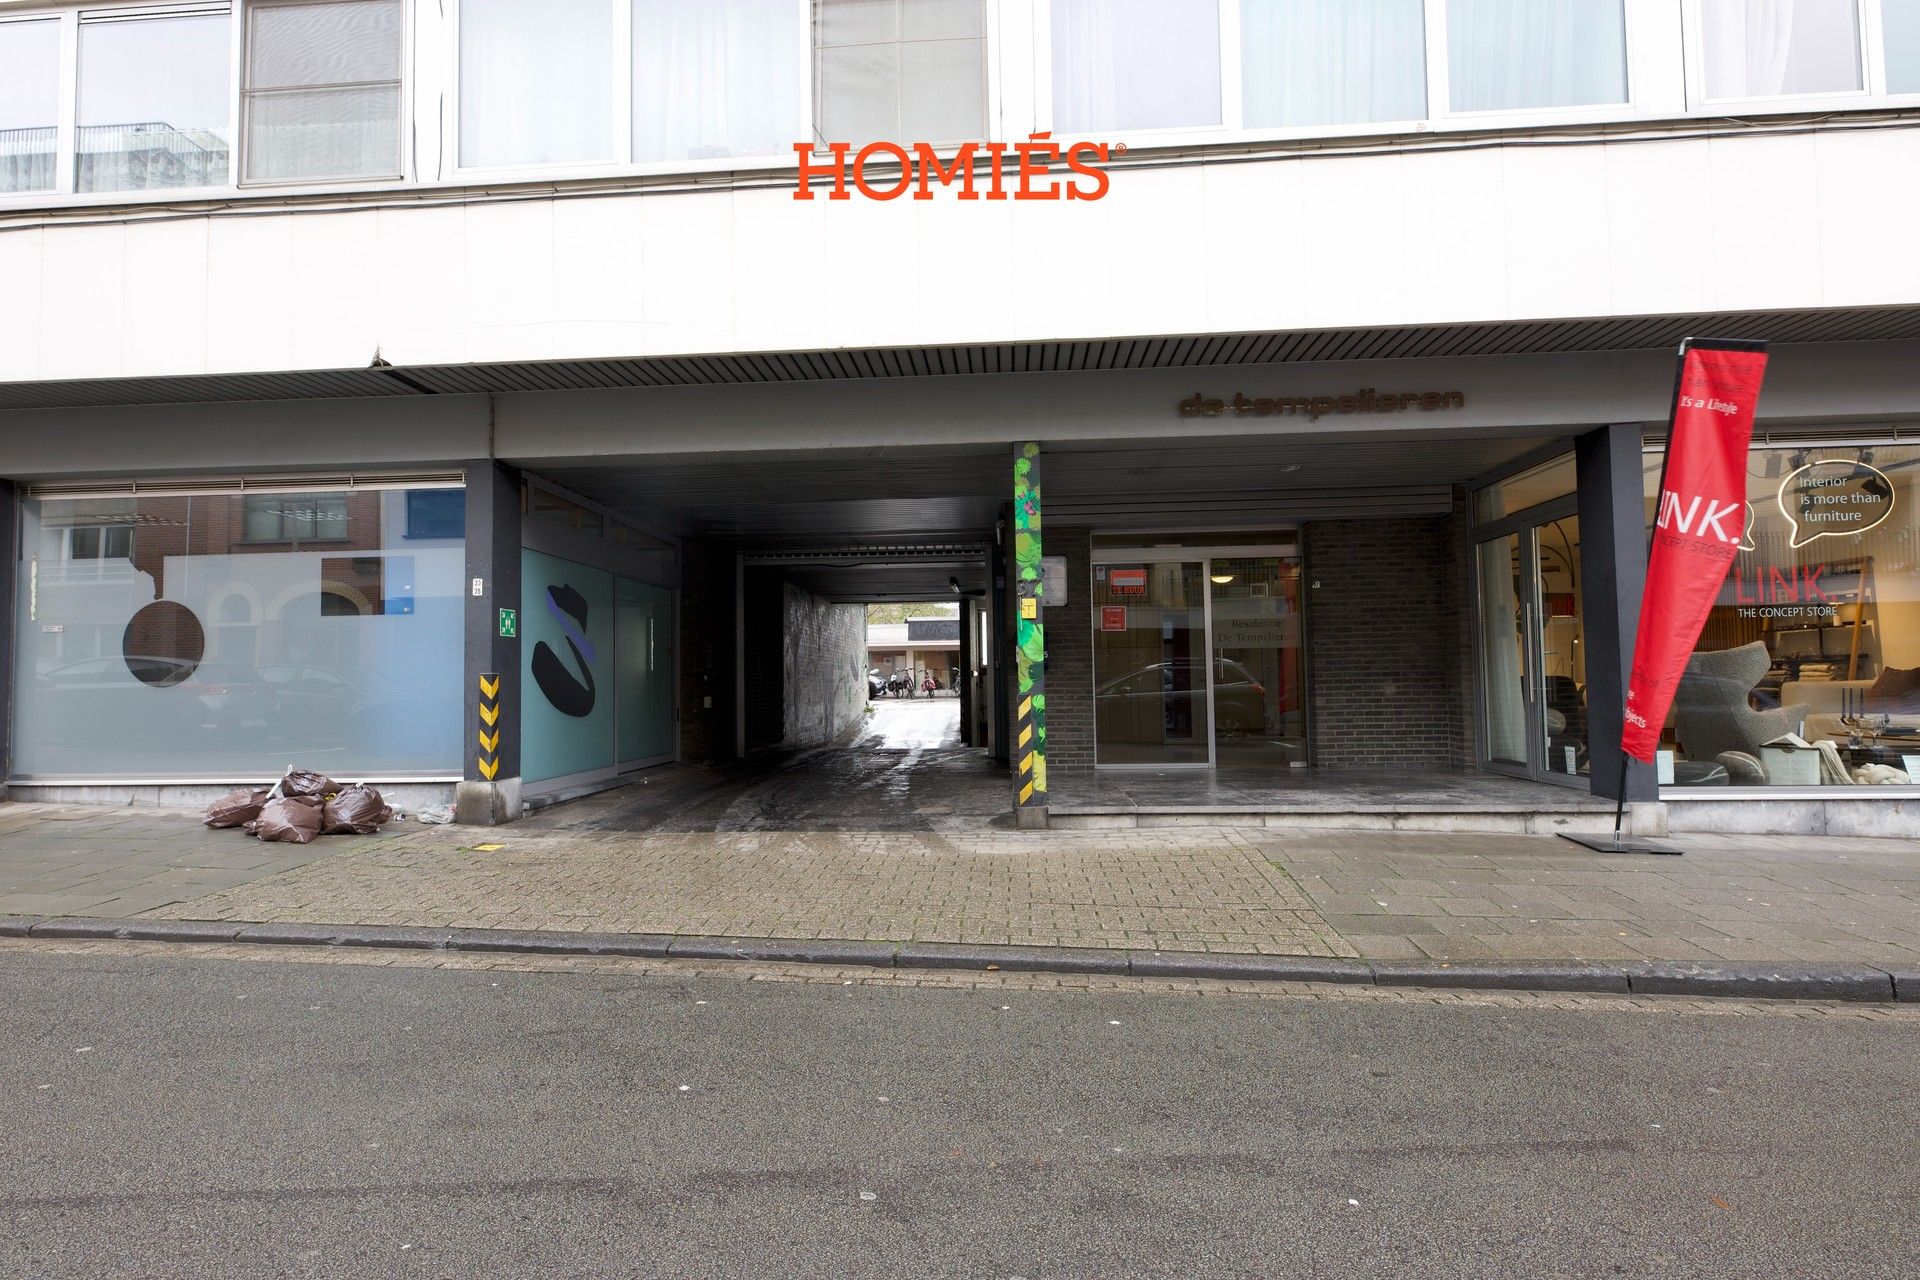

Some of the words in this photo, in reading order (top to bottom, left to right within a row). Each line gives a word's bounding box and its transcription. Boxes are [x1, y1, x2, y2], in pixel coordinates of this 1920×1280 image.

[1179, 392, 1225, 417] de
[1694, 399, 1705, 408] a
[1799, 476, 1848, 487] Interior
[1800, 495, 1811, 505] is
[1813, 495, 1848, 505] more
[1851, 492, 1881, 504] than
[1803, 510, 1862, 522] furniture
[1738, 608, 1757, 618] THE
[1759, 607, 1805, 618] CONCEPT
[1807, 606, 1838, 617] STORE
